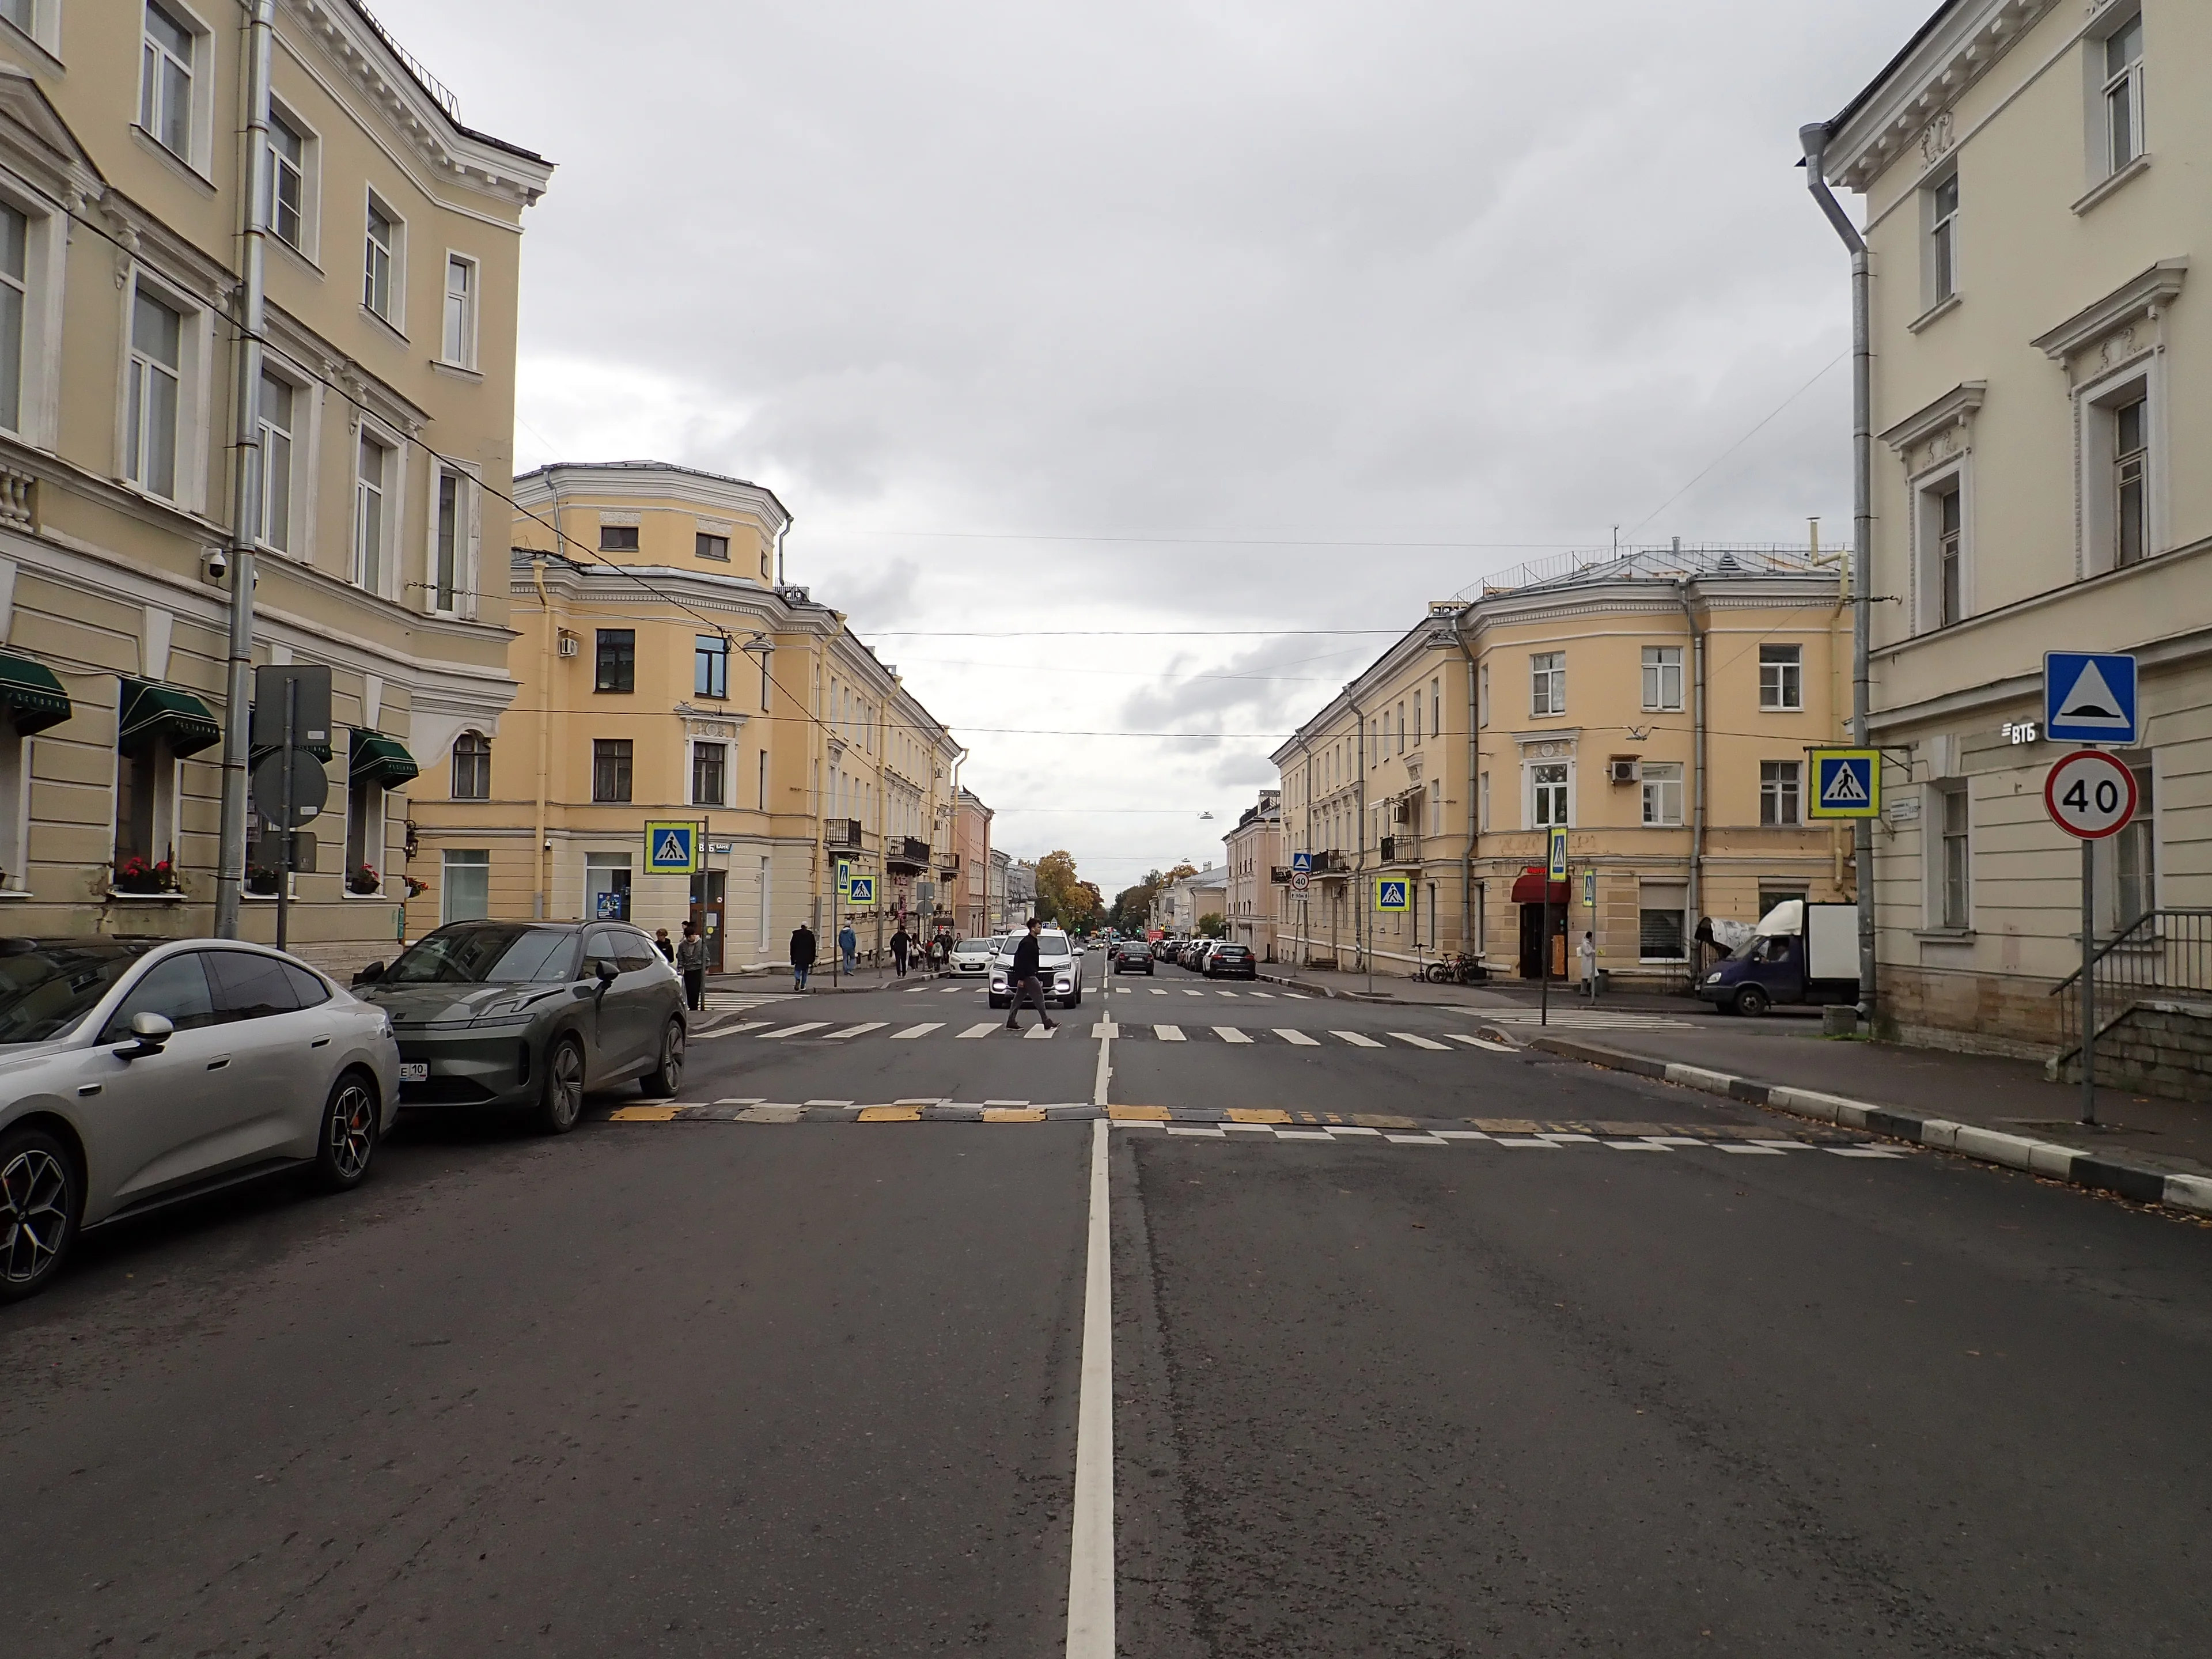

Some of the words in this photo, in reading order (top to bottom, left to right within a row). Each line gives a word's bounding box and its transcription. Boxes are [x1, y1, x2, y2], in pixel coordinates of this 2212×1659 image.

[2012, 722, 2035, 744] ВТБ
[2063, 779, 2118, 813] 40
[699, 843, 714, 852] ВБ
